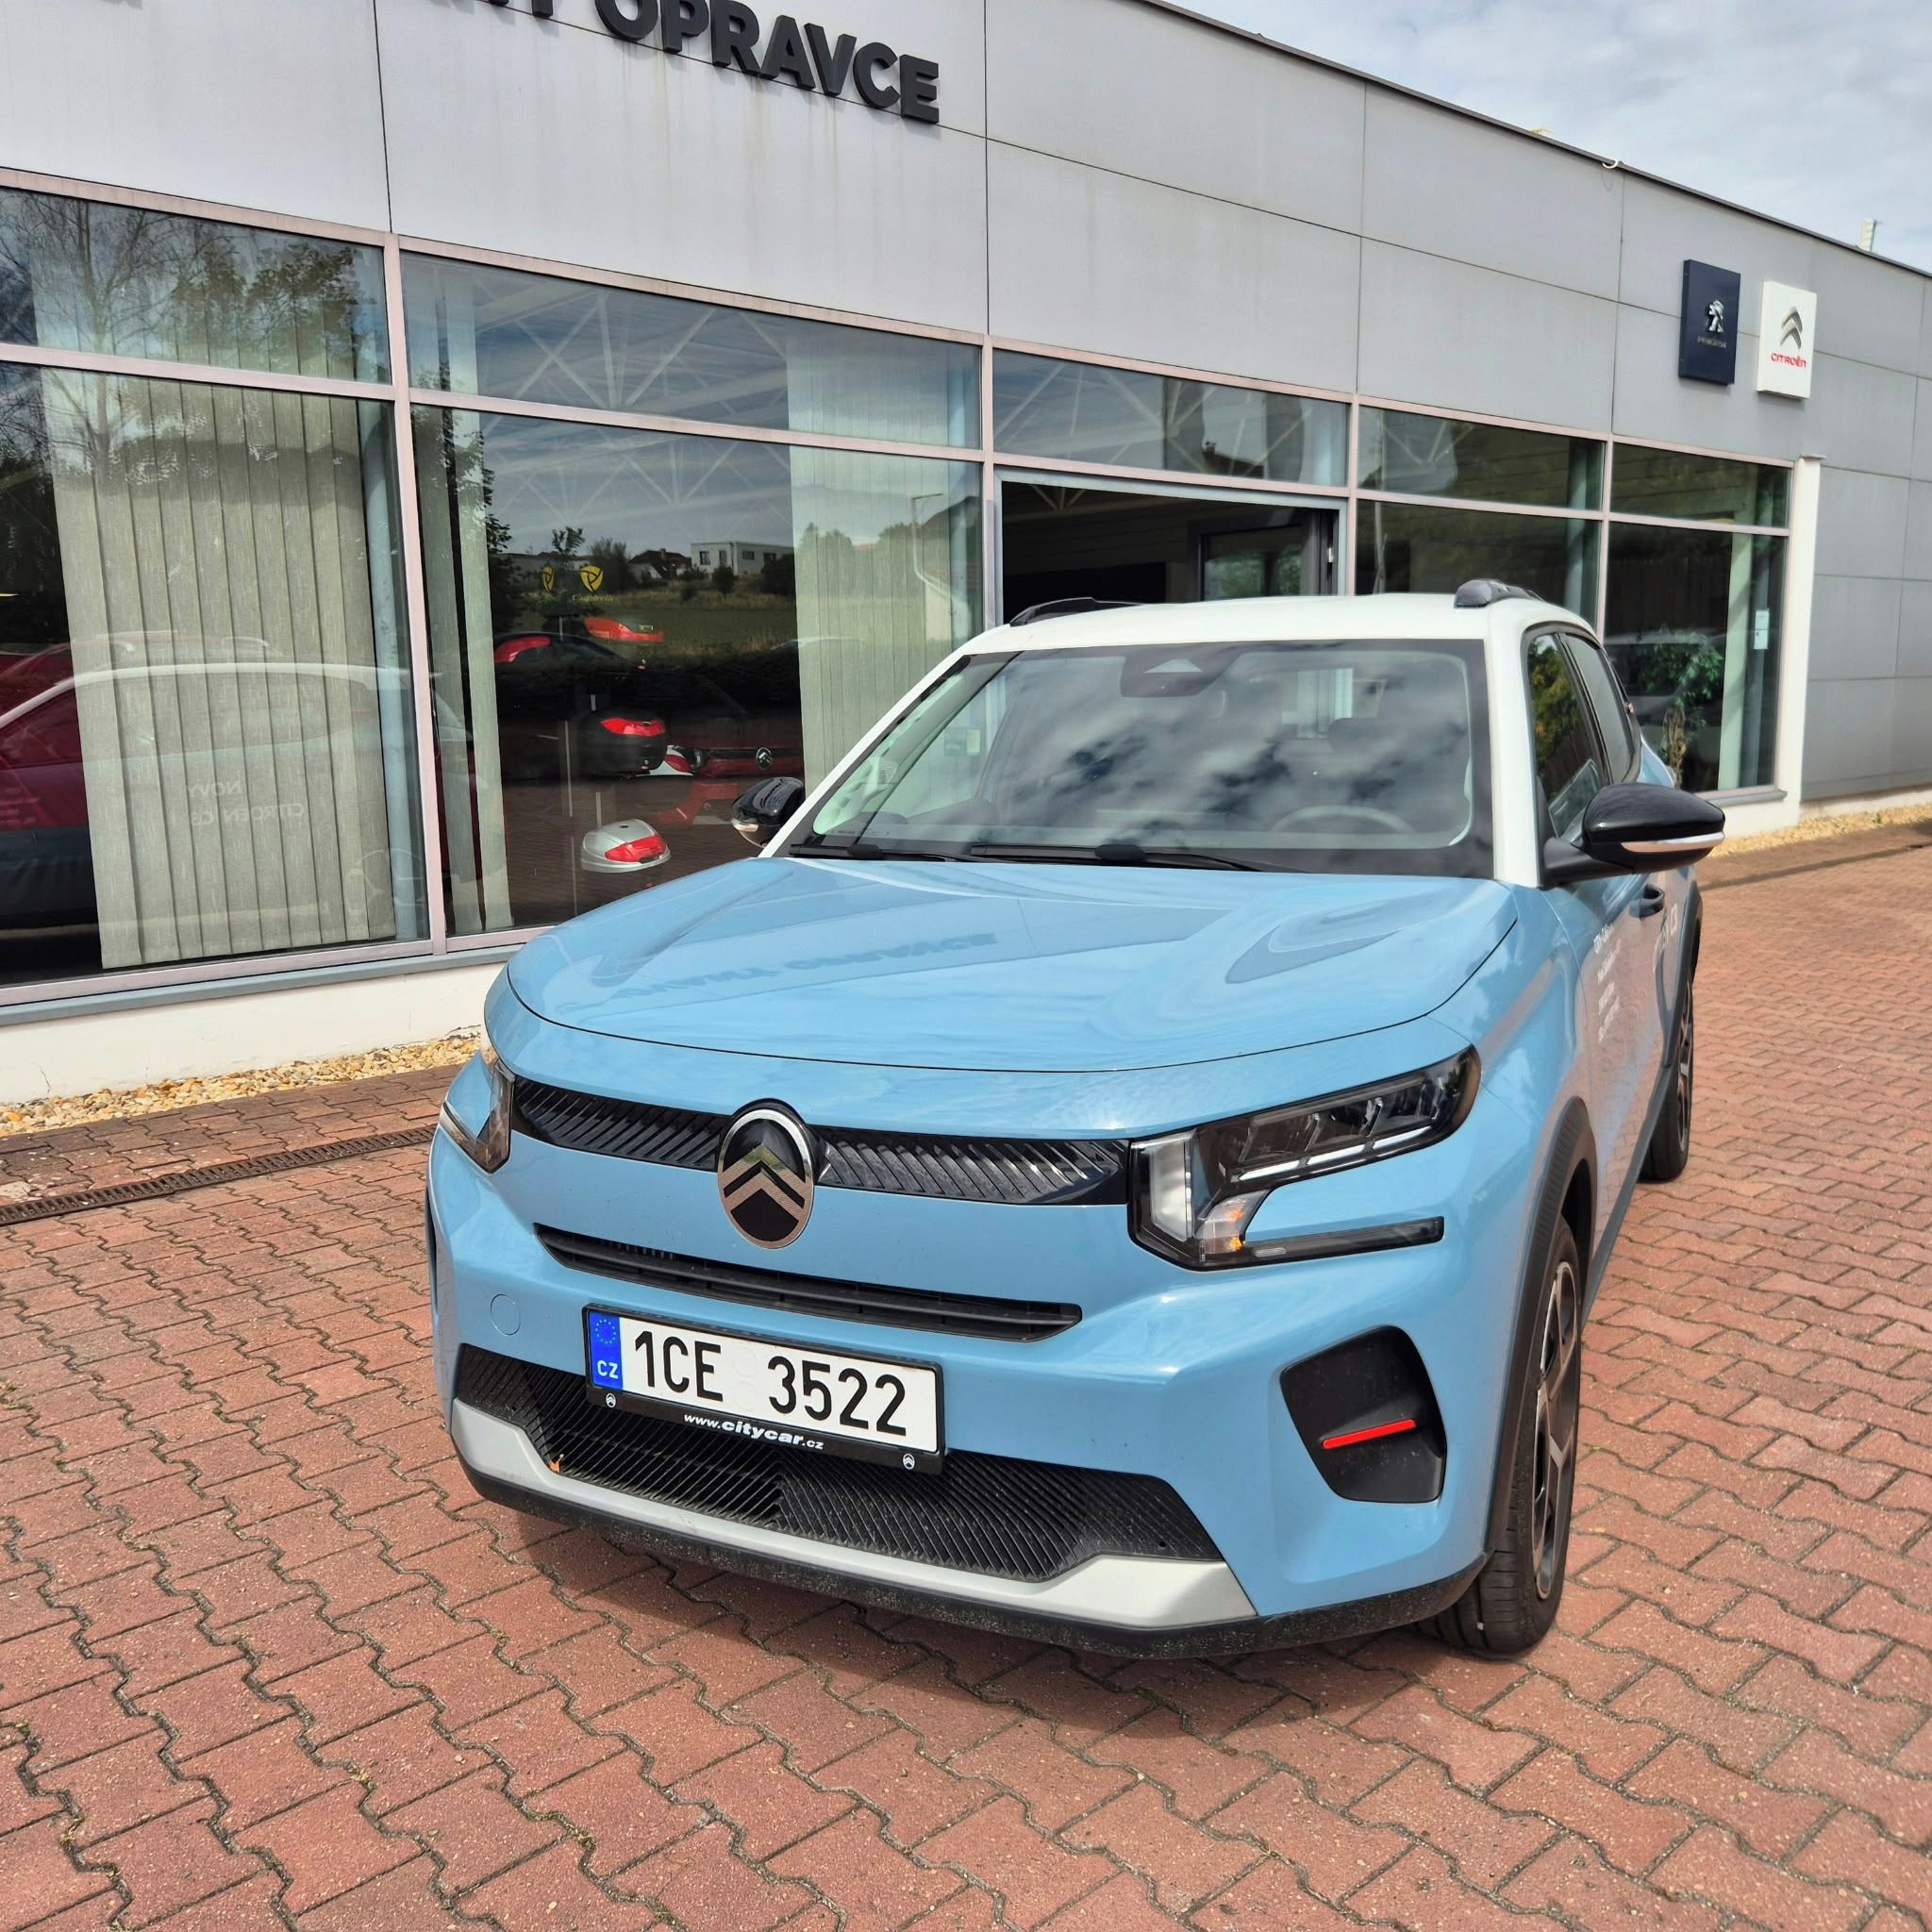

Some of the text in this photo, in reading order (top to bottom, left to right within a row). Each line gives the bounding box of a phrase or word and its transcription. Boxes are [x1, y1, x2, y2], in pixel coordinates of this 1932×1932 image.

[596, 0, 940, 124] OPRAVCE
[597, 1359, 619, 1379] CZ
[635, 1330, 907, 1437] 1CE 3522
[683, 1413, 824, 1450] www.citycar.cz
